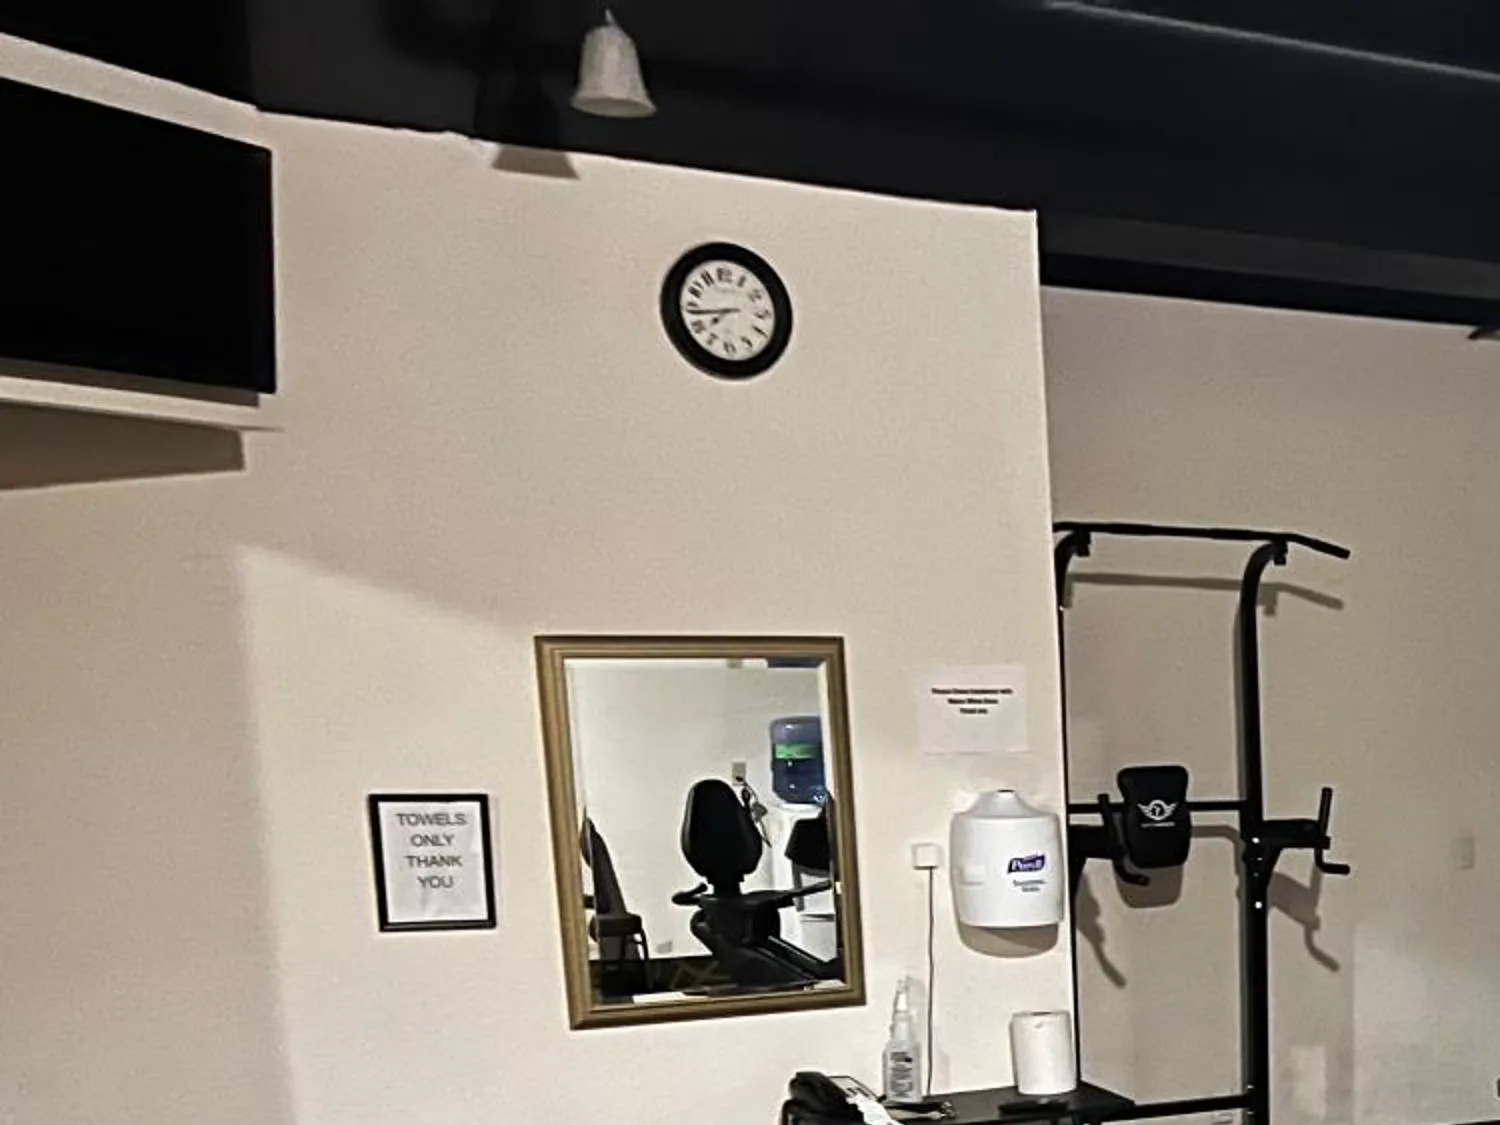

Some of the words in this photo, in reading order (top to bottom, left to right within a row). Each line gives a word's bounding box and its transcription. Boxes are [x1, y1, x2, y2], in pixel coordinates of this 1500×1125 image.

[396, 813, 468, 827] TOWELS
[410, 834, 456, 848] ONLY
[404, 855, 463, 869] THANK
[417, 875, 454, 889] YOU
